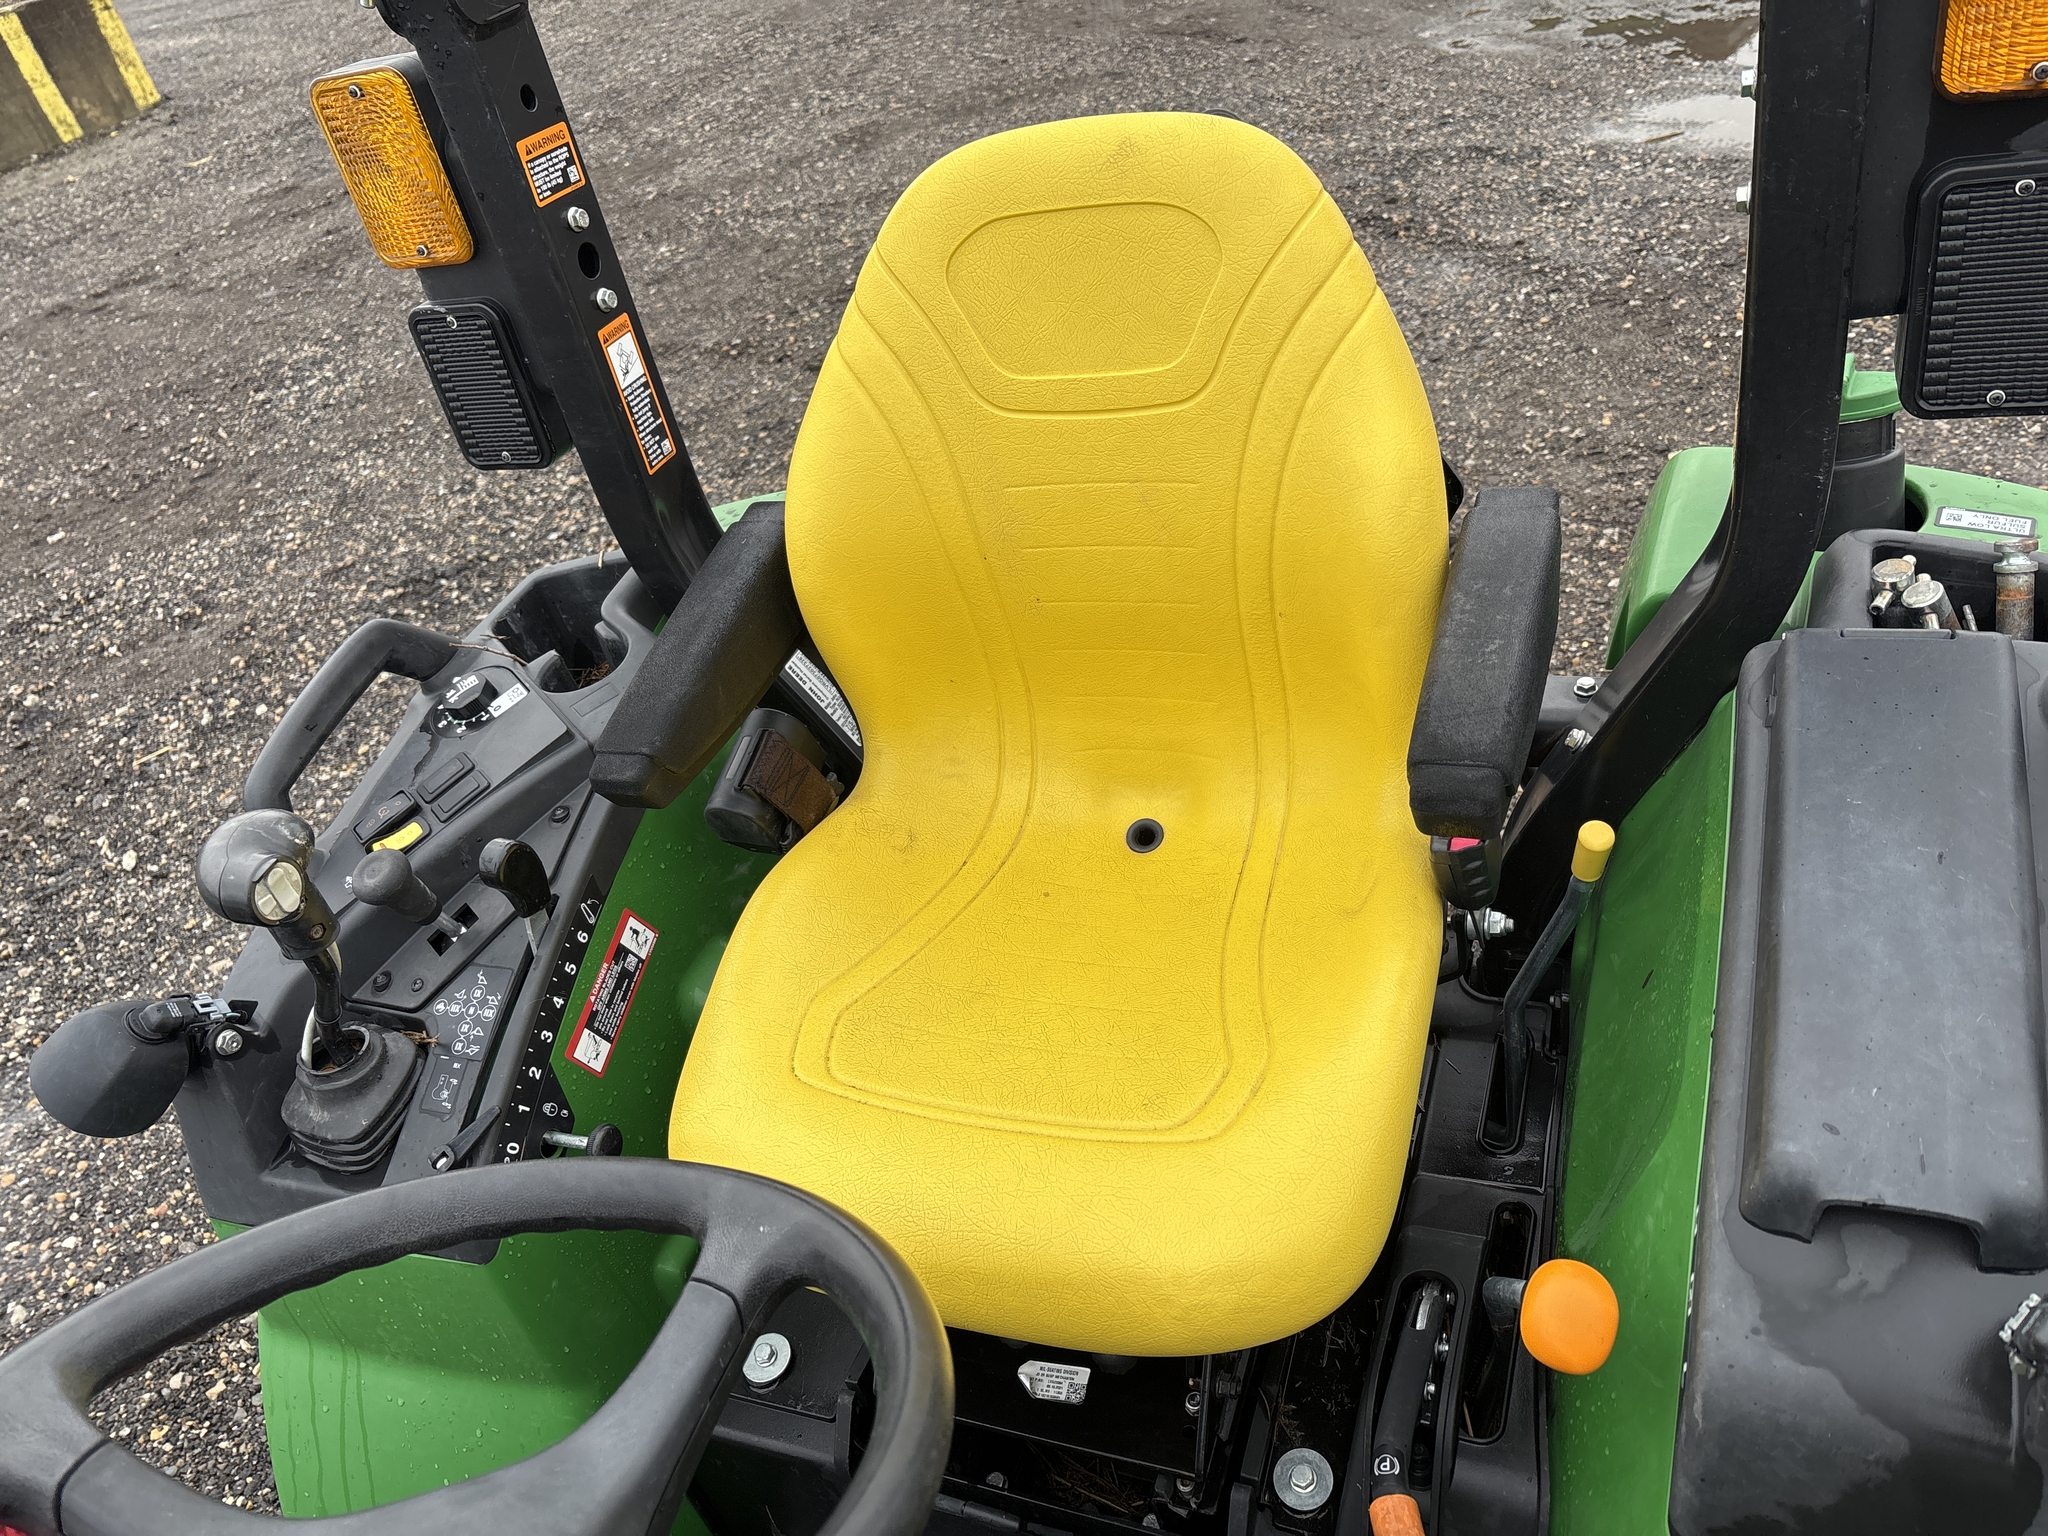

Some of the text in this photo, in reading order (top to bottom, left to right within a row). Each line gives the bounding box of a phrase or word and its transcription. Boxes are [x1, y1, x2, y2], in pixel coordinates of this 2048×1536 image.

[530, 130, 565, 152] WARNING
[607, 320, 630, 340] WARNING
[1987, 520, 2025, 528] SULFUR
[788, 665, 807, 685] DEERE
[809, 687, 824, 703] JOHN
[577, 930, 589, 944] 6
[564, 961, 577, 976] 5
[593, 963, 608, 994] DANGER
[552, 995, 565, 1009] 4
[540, 1029, 554, 1043] 3
[528, 1067, 542, 1080] 2
[517, 1104, 531, 1114] 1
[507, 1142, 520, 1155] 0
